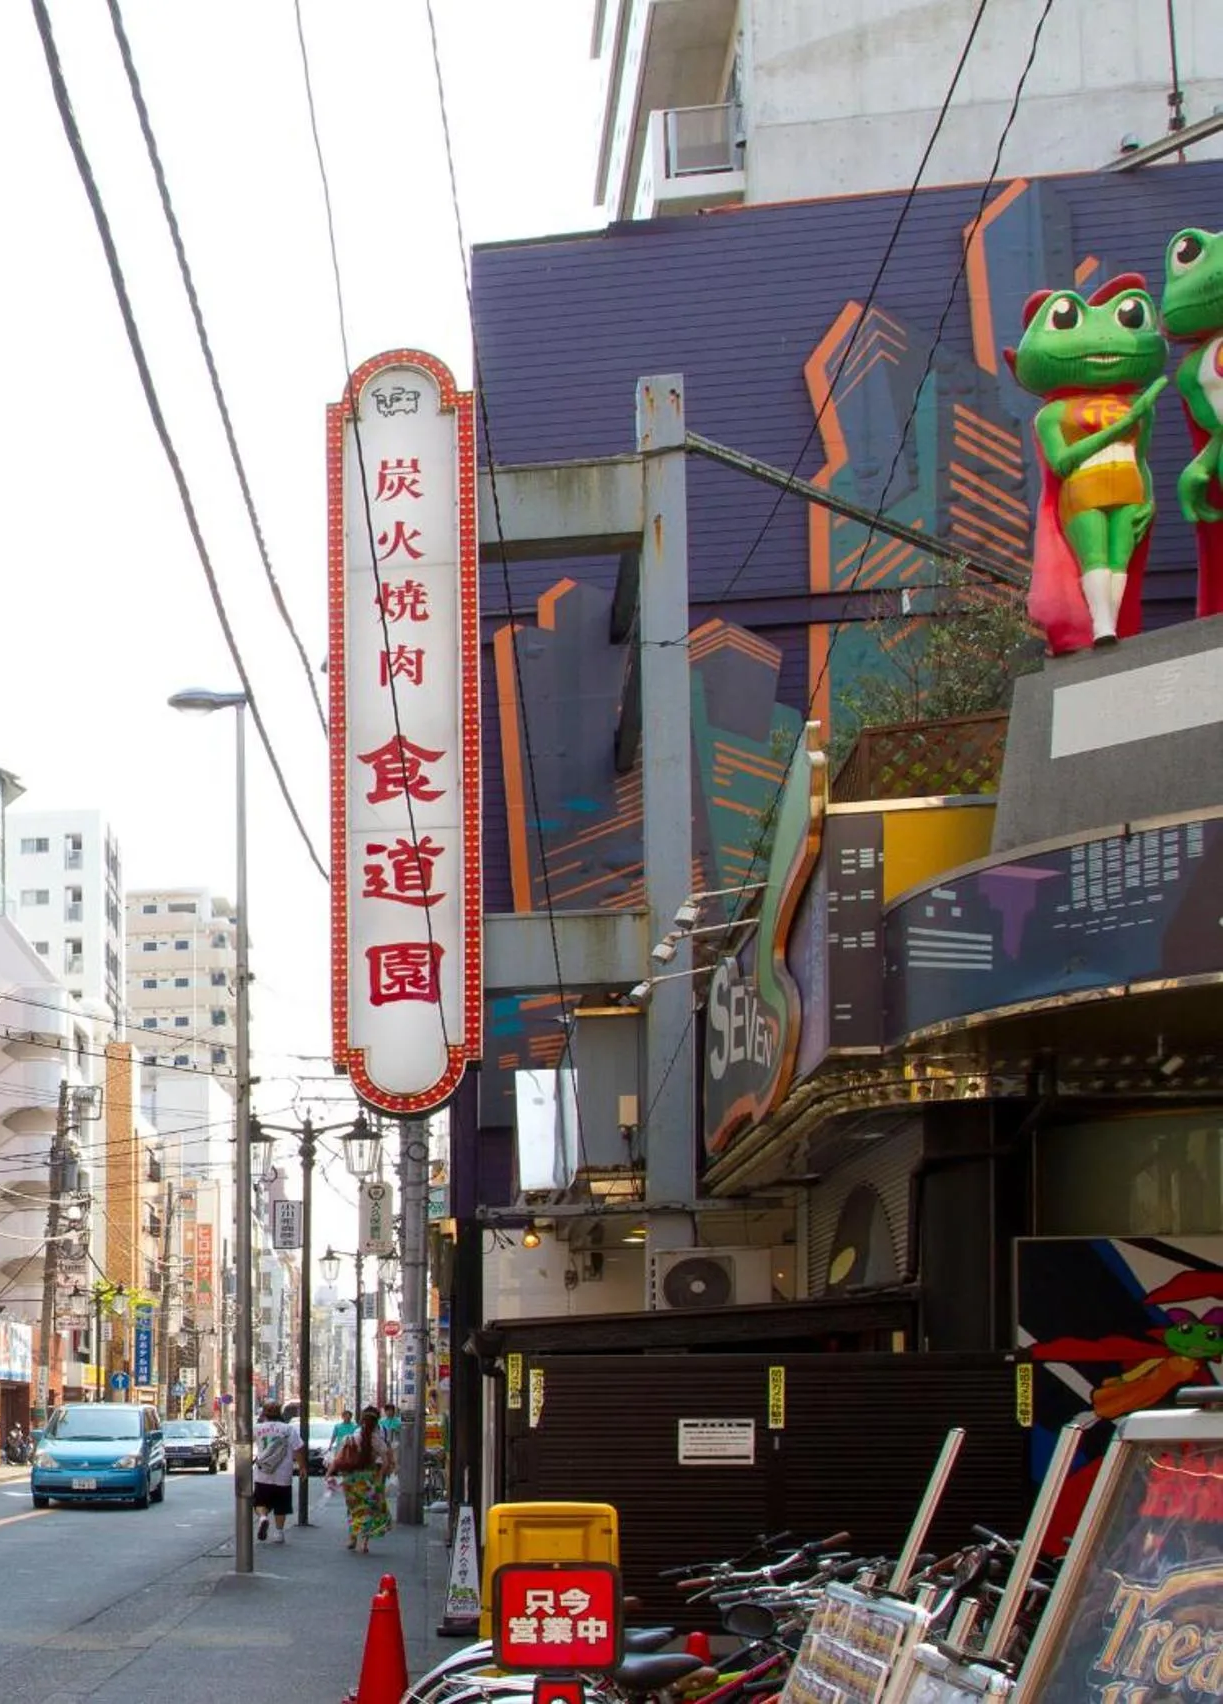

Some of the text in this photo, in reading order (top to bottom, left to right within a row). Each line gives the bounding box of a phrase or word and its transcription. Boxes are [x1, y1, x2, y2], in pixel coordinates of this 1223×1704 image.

[375, 457, 430, 687] 炭火焼肉
[357, 733, 447, 1006] 食道園
[508, 1617, 608, 1645] 営業中
[525, 1588, 591, 1616] 只今
